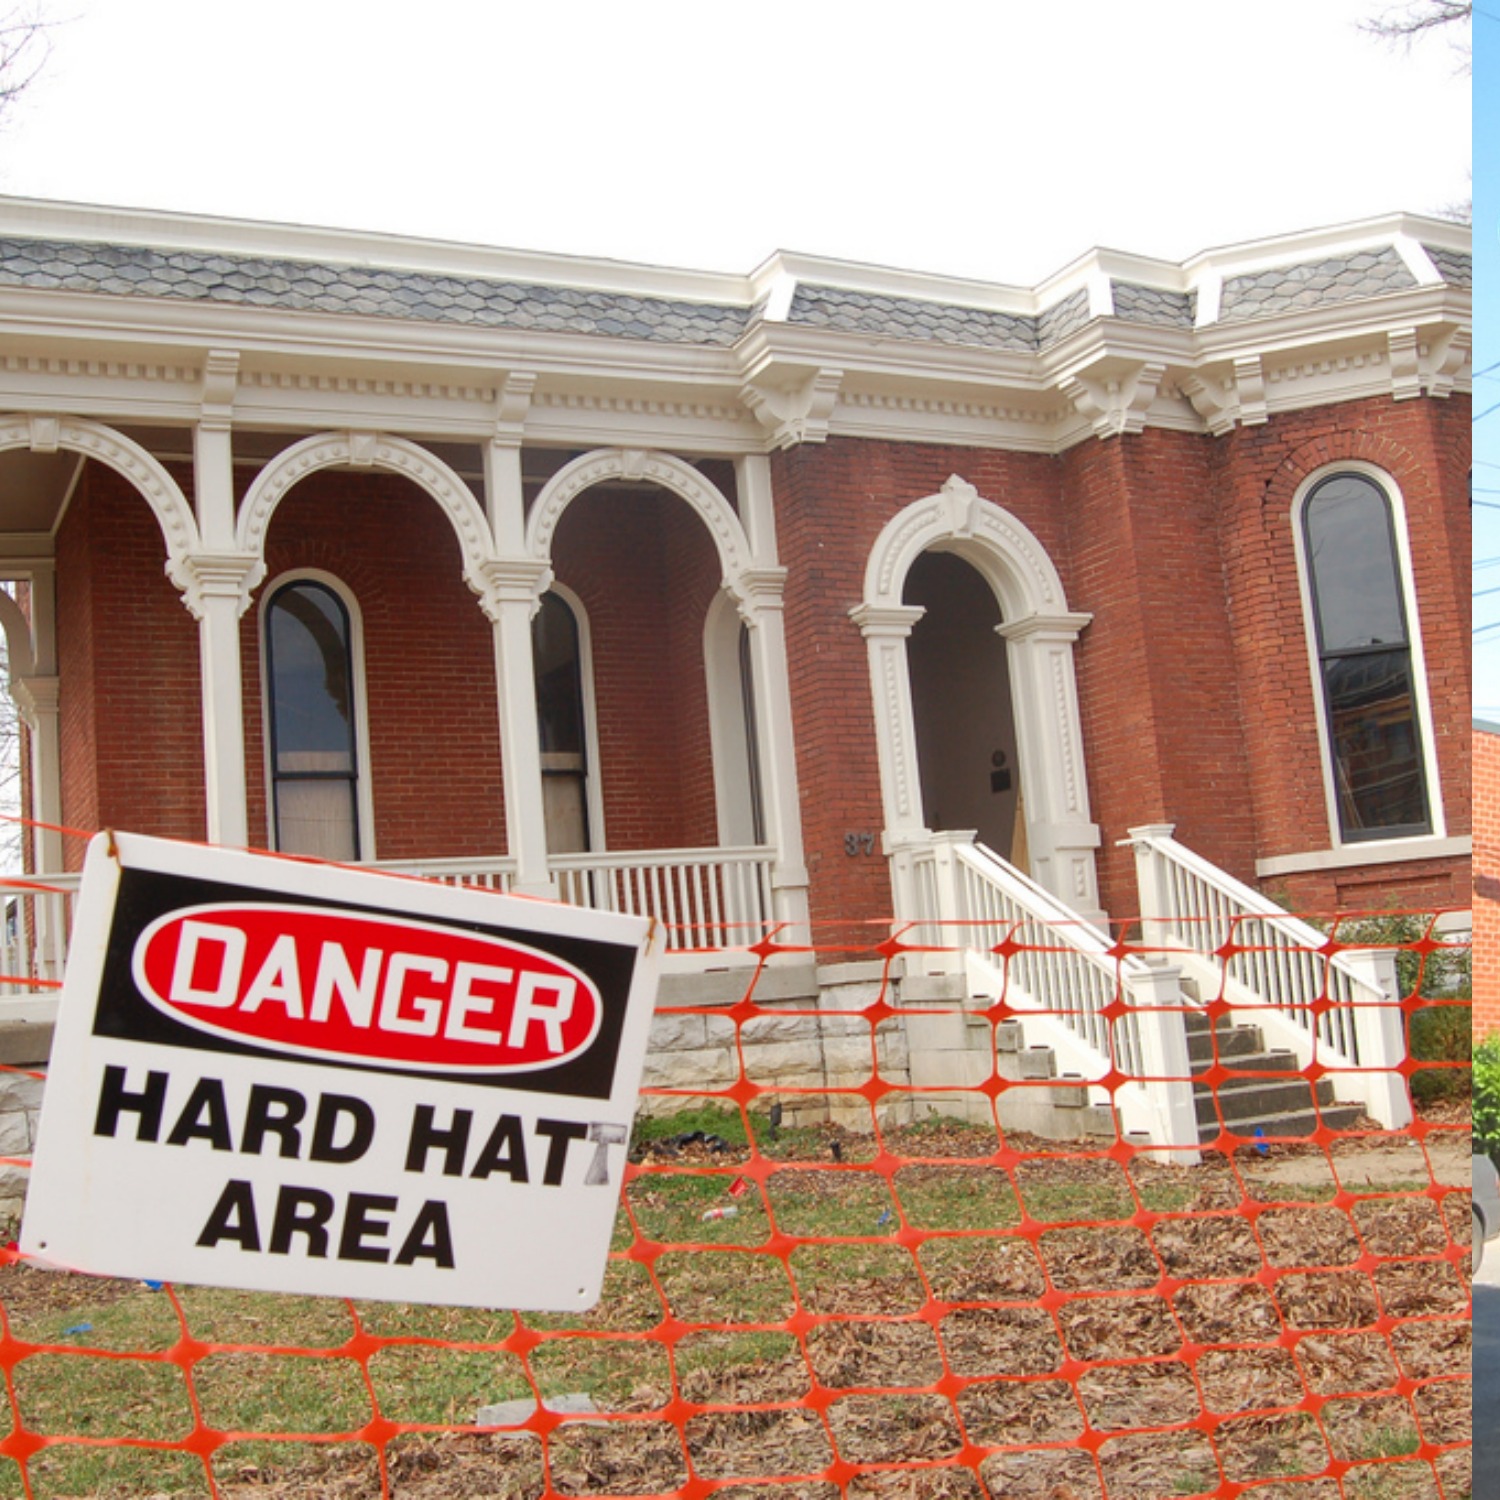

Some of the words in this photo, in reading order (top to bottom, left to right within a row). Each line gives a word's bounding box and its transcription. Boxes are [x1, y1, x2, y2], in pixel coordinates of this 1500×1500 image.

[168, 918, 578, 1055] DANGER
[93, 1064, 377, 1164] HARD
[195, 1179, 456, 1270] AREA
